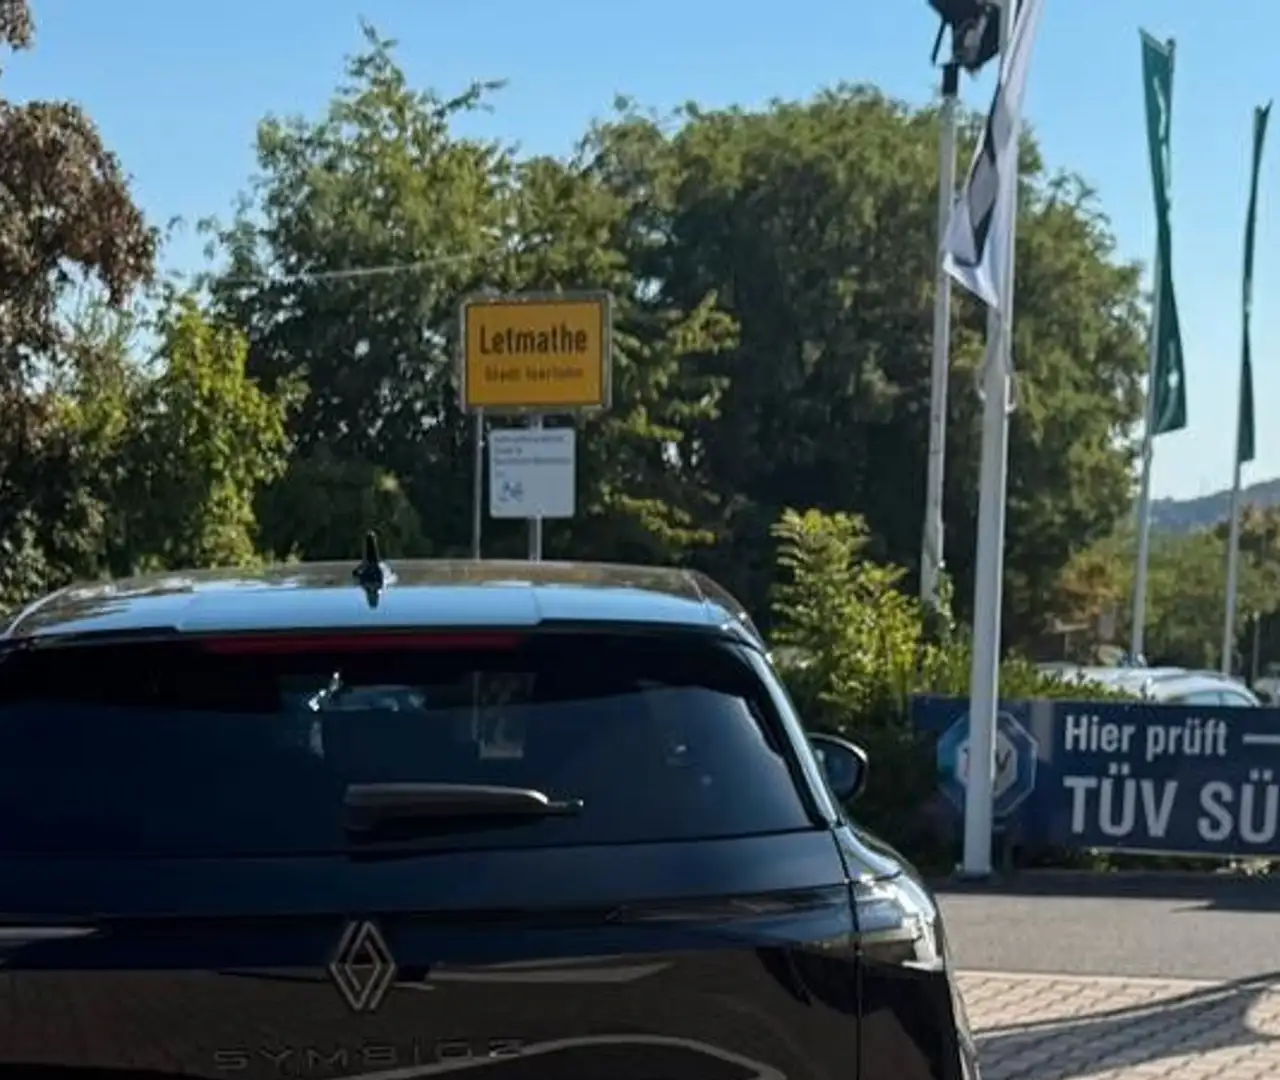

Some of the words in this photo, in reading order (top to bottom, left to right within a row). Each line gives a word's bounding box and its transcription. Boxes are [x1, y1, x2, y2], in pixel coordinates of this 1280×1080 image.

[480, 323, 587, 355] Letmathe
[1064, 715, 1135, 754] Hier
[1146, 716, 1228, 762] prüft
[1063, 762, 1178, 838] TÜV
